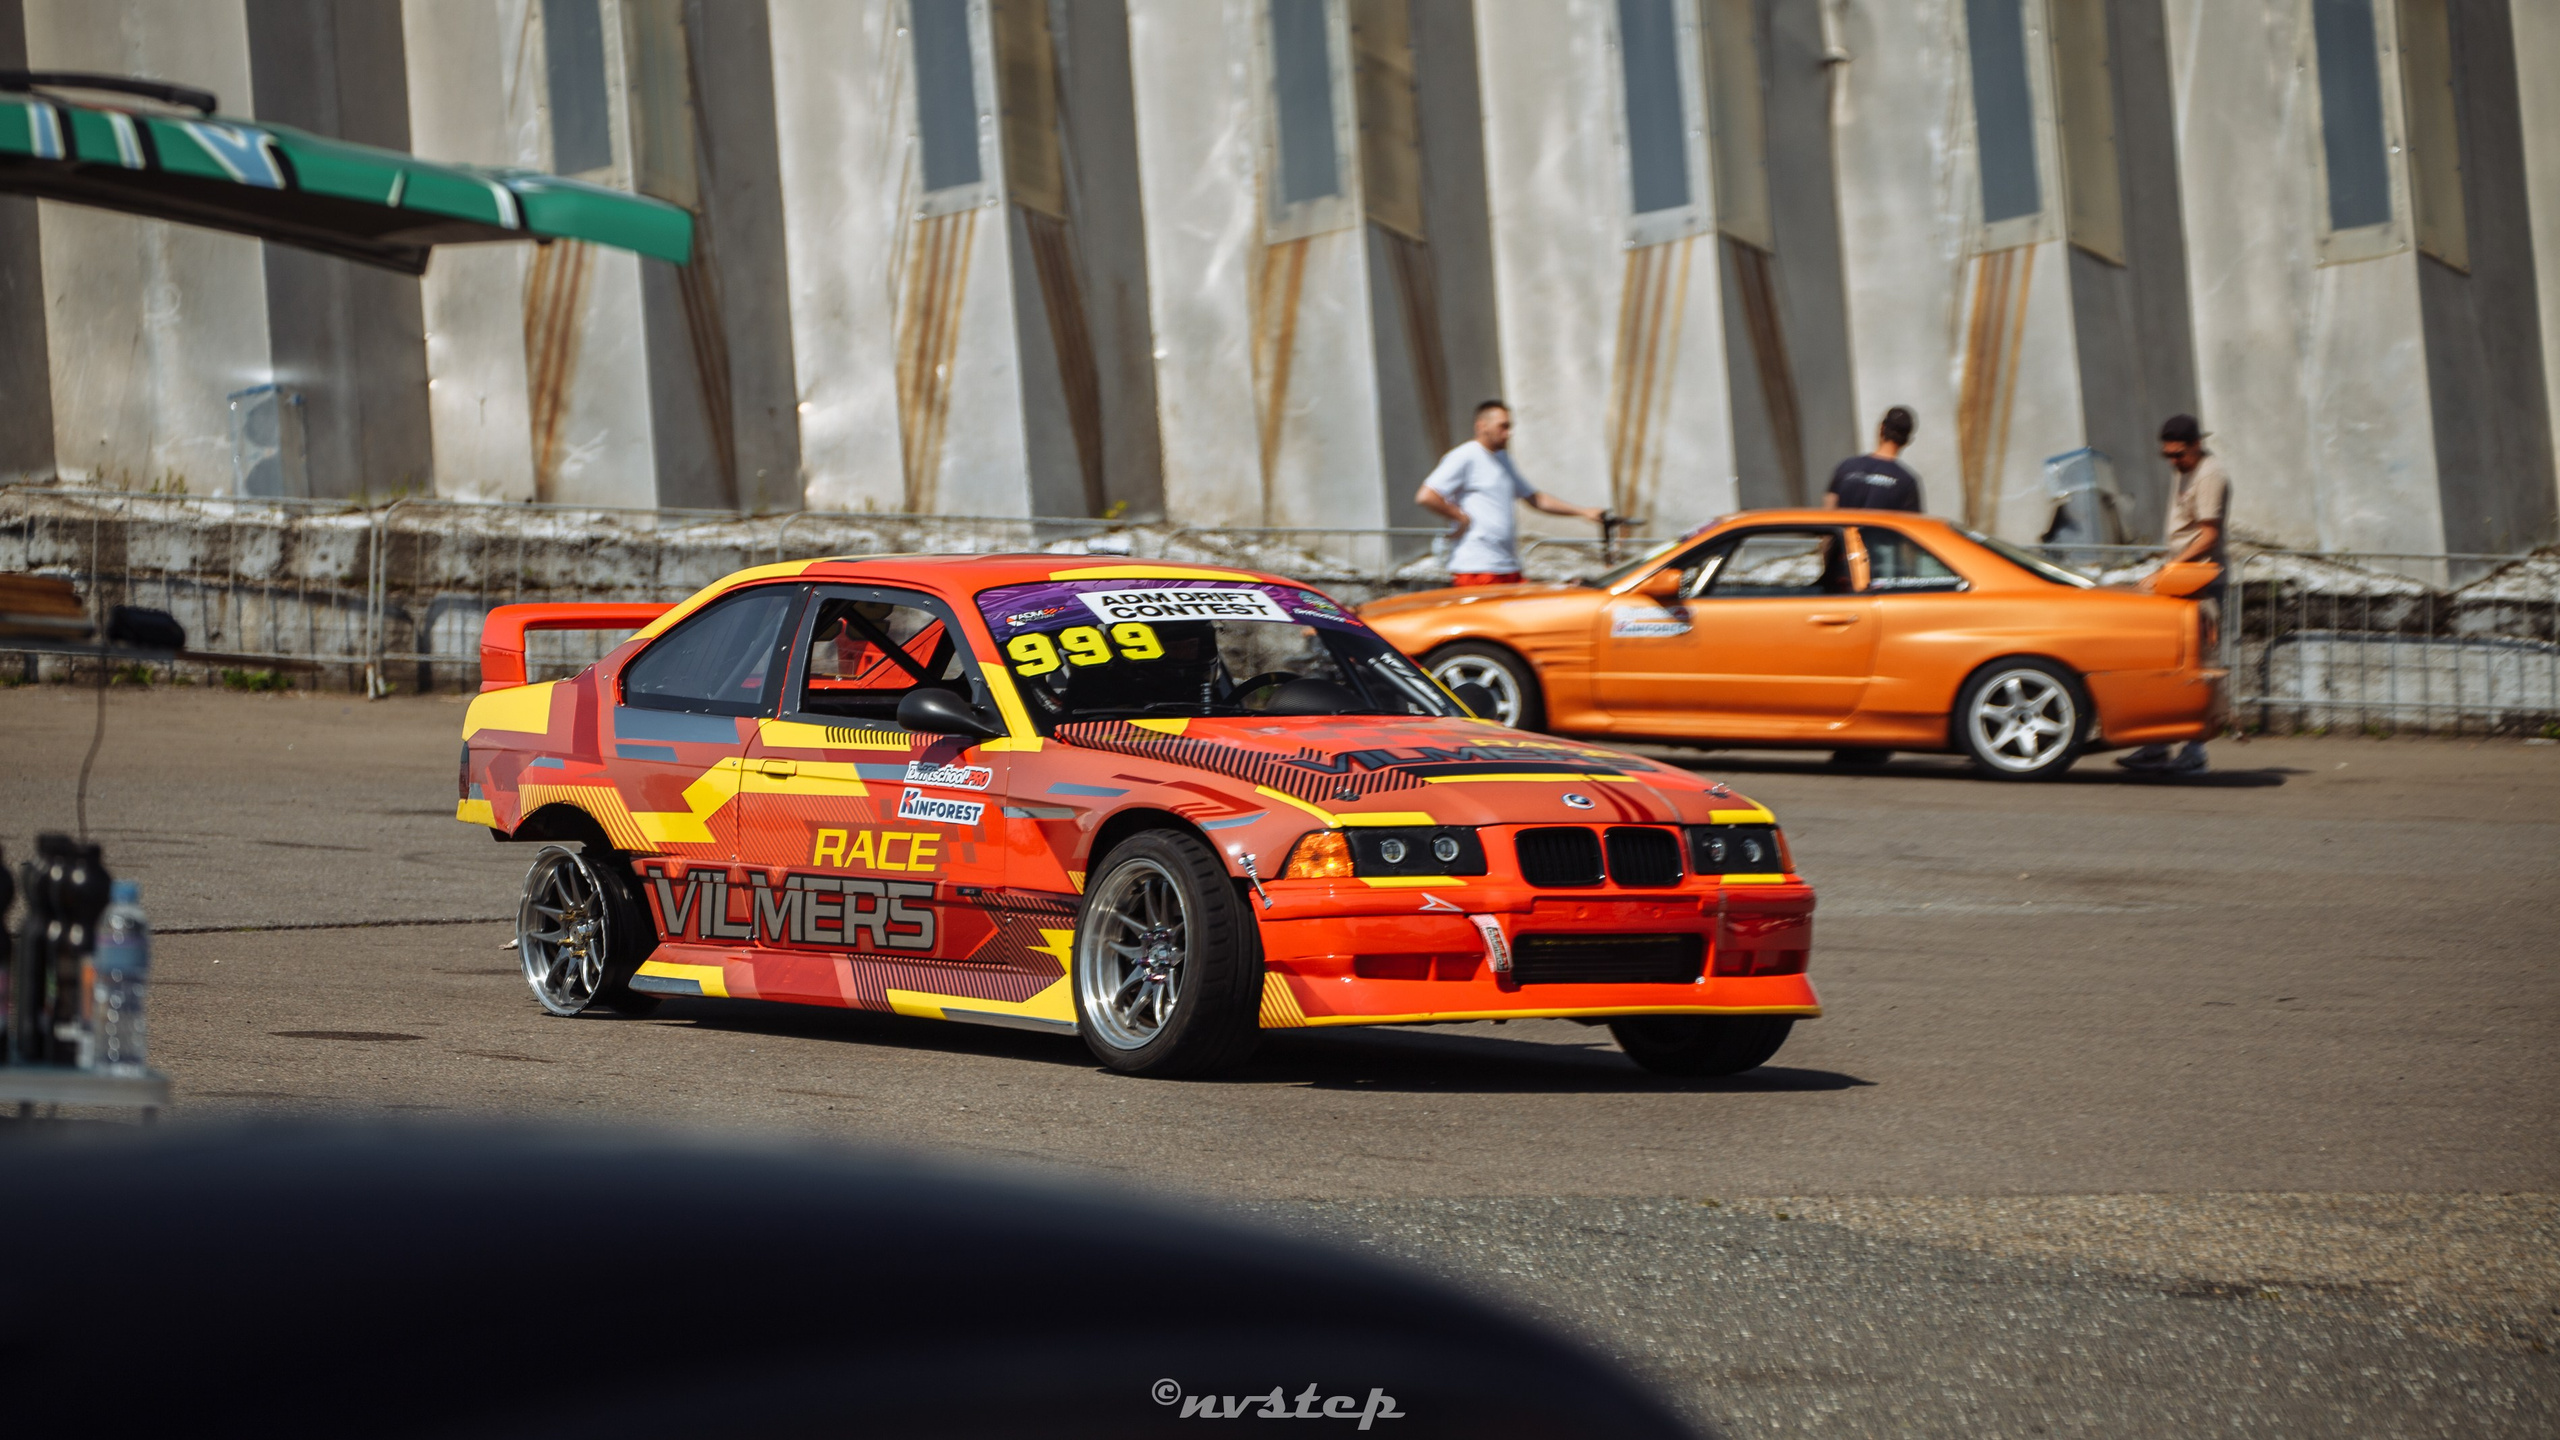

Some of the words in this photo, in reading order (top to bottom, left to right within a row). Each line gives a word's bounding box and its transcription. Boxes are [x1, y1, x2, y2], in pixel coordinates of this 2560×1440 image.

[1101, 593, 1172, 606] ADM
[1172, 592, 1255, 603] DRIFT
[1109, 603, 1269, 618] CONTEST
[1006, 621, 1166, 678] 999
[1286, 745, 1657, 775] VILMERS
[900, 791, 982, 822] KINFOREST
[813, 828, 941, 872] RACE
[646, 867, 935, 950] VILMERS
